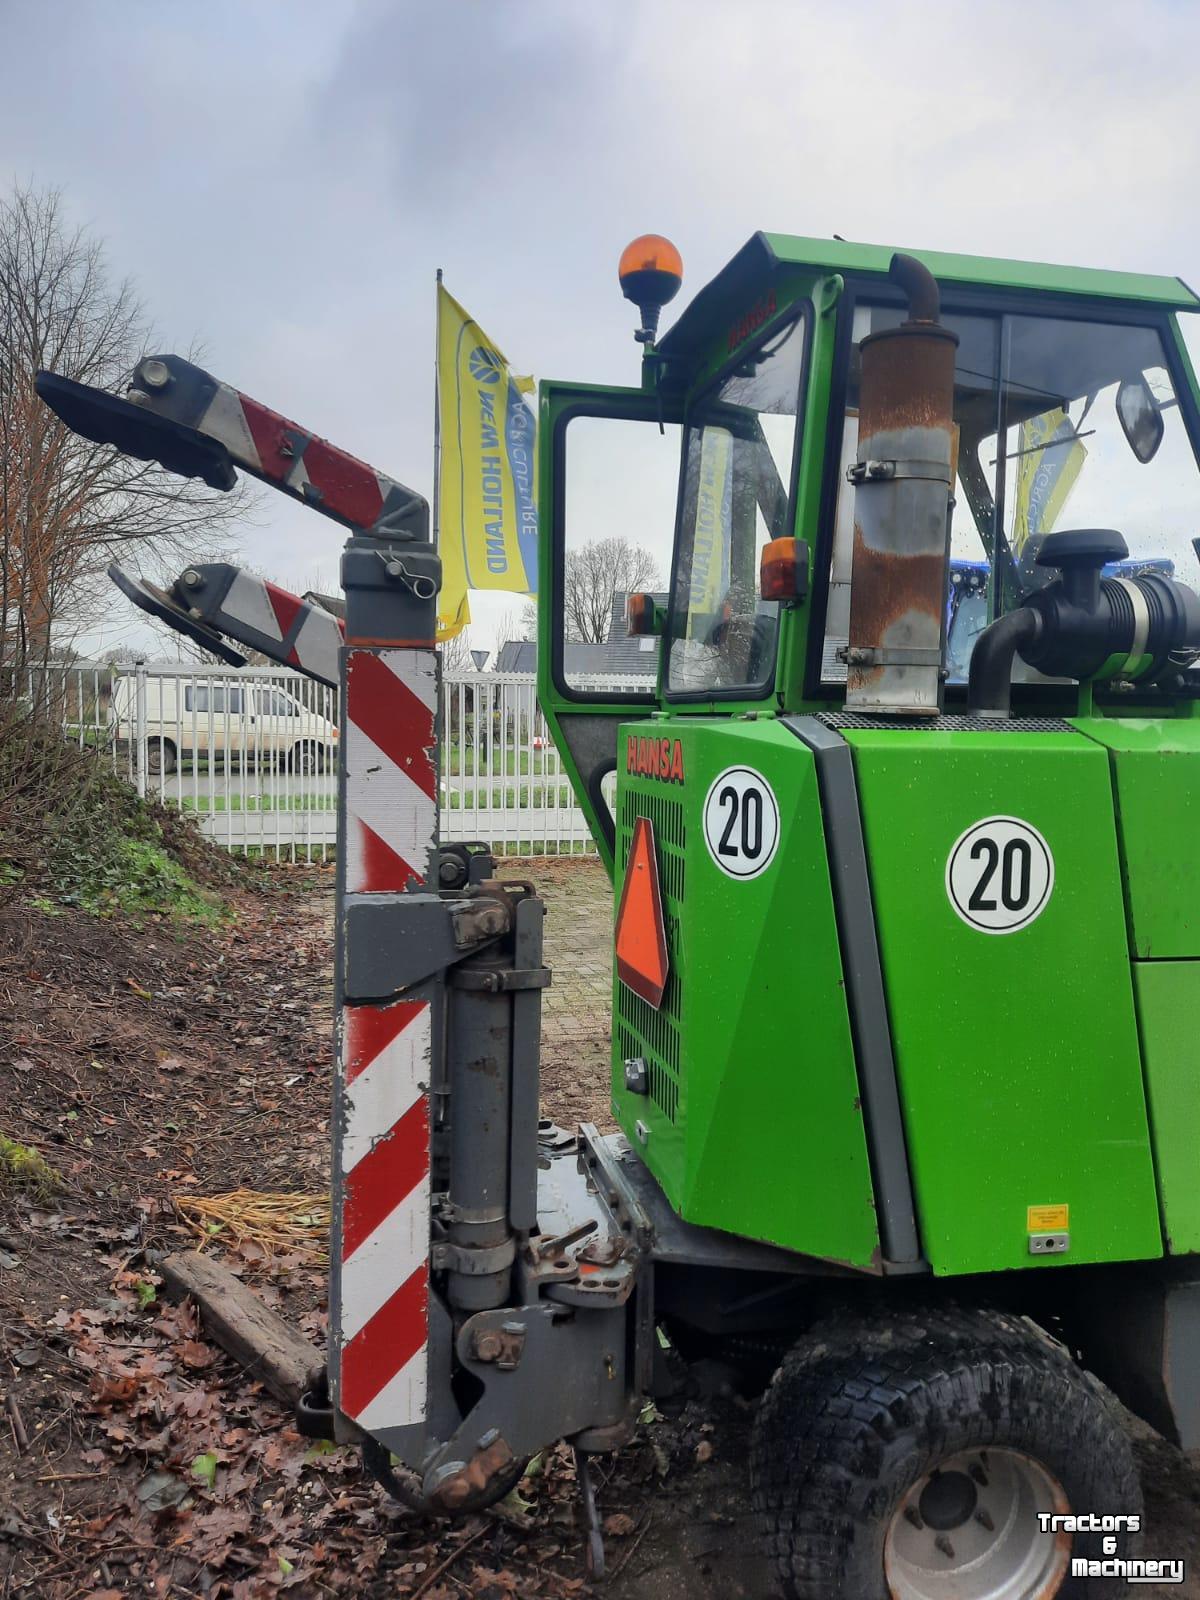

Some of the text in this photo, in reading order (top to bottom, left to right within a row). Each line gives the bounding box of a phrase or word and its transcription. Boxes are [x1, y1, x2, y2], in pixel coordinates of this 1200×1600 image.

[627, 735, 685, 786] HANSA
[718, 786, 763, 859] 20
[968, 837, 1031, 911] 20
